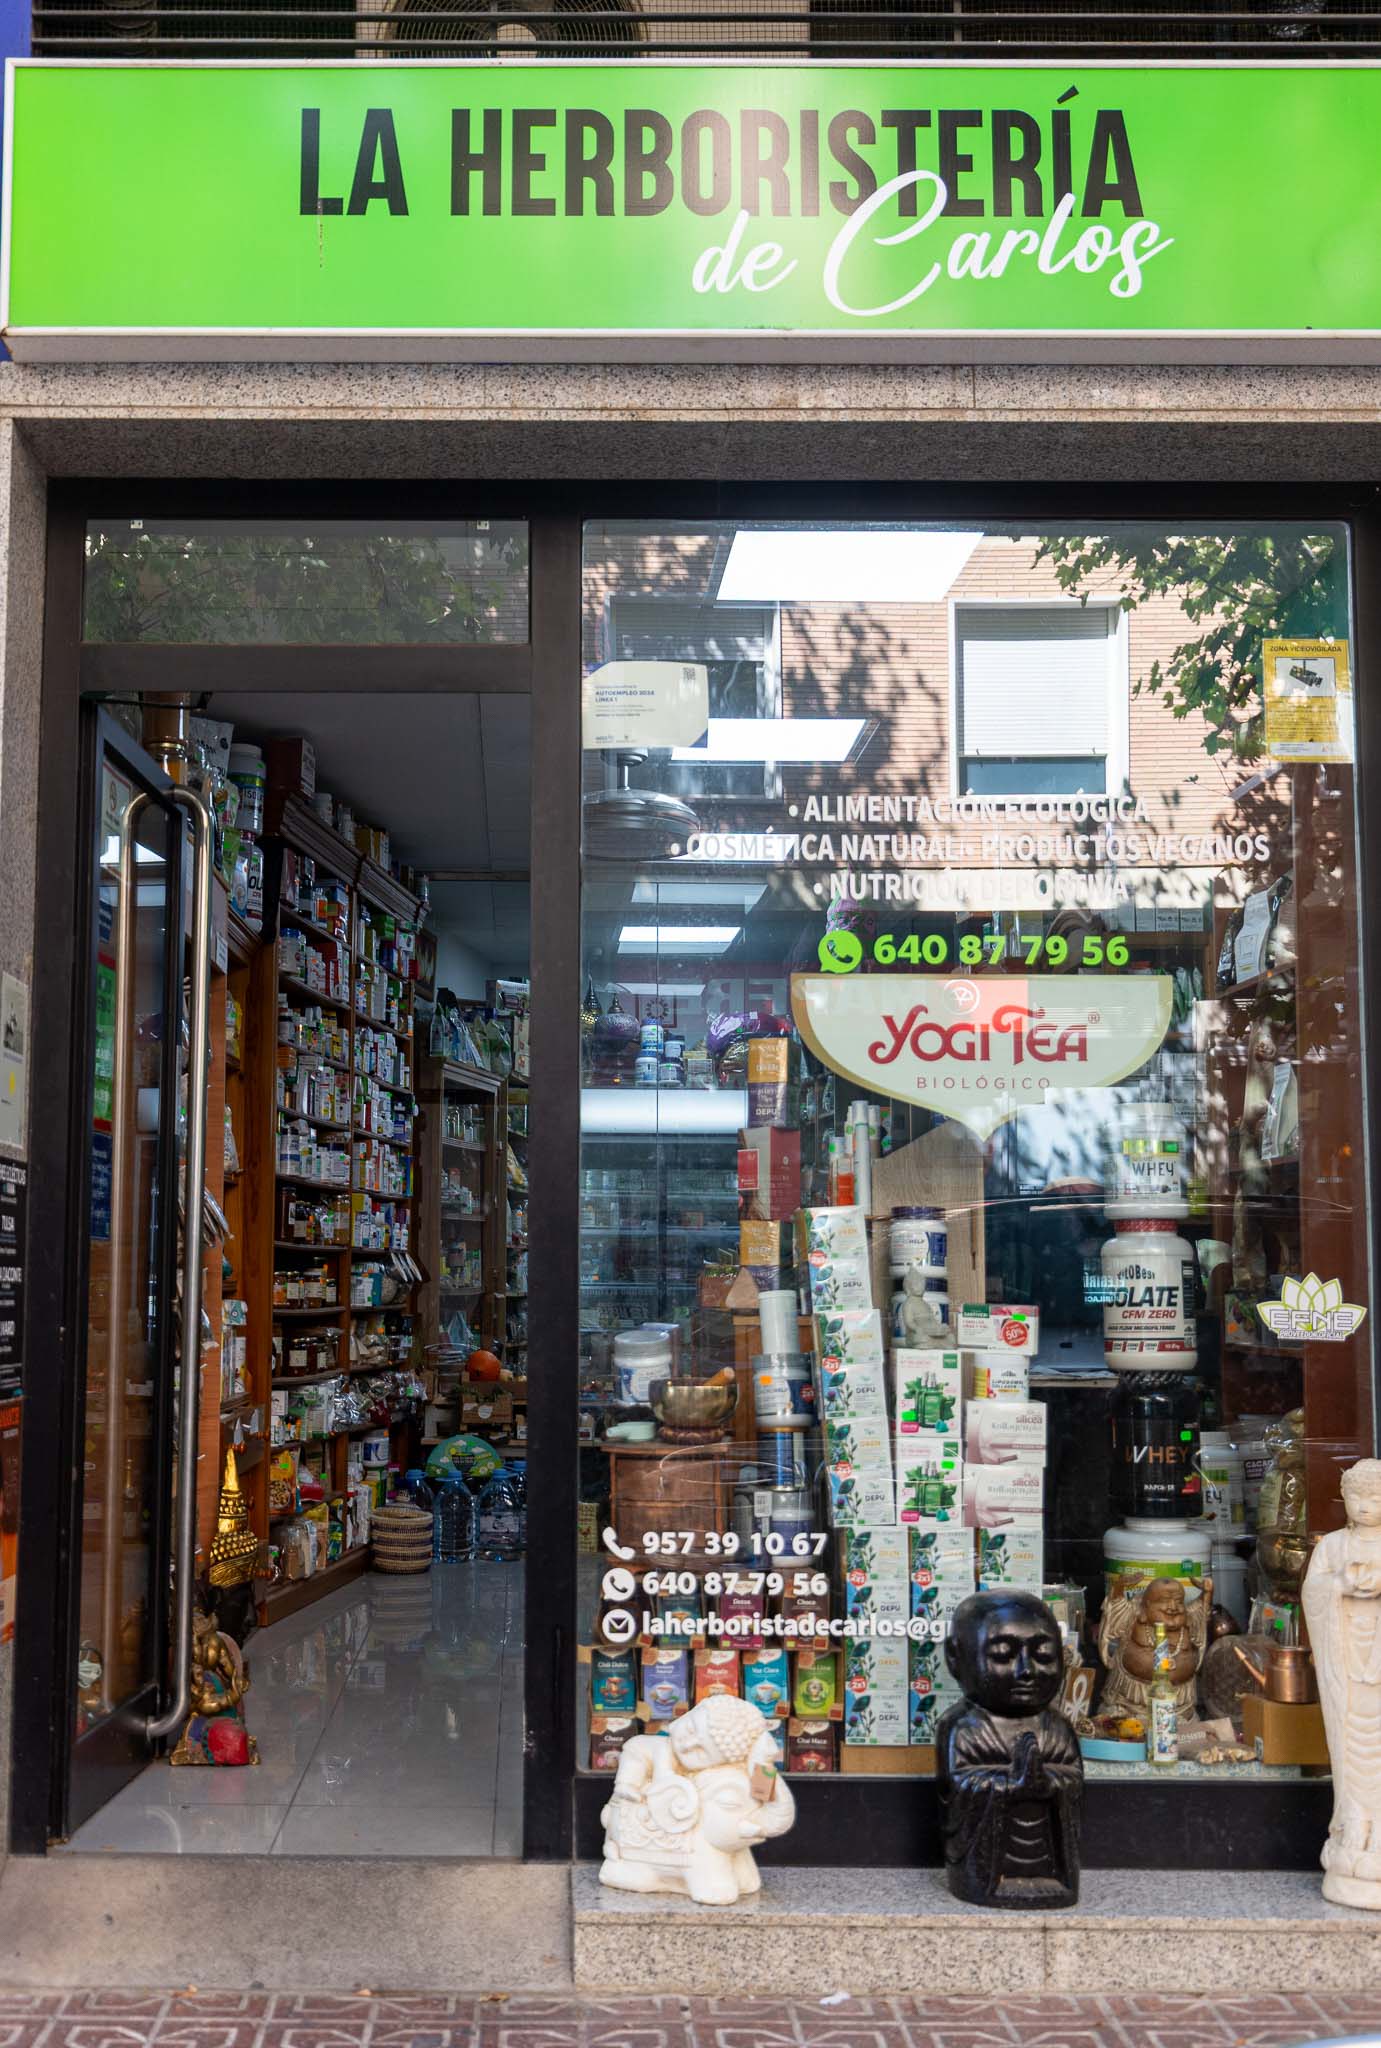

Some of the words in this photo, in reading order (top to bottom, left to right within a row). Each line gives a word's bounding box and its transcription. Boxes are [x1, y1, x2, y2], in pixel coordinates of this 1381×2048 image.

[299, 107, 410, 217] LA
[450, 84, 1144, 217] HERBORISTERÍA
[691, 208, 798, 293] de
[823, 169, 1175, 316] Carlos
[803, 787, 1001, 823] ALIMENTACIÓN
[1006, 787, 1149, 823] ECOLÓGICA
[686, 825, 835, 861] COSMÉTICA
[841, 834, 960, 861] NATURAL
[980, 834, 1143, 862] PRODUCTOS
[1146, 834, 1271, 862] VEGANOS
[873, 935, 948, 965] 640
[959, 936, 1006, 965] 87
[1021, 936, 1068, 965] 79
[1082, 936, 1130, 967] 56
[916, 1076, 1051, 1090] BIOLÓGICO
[1132, 1162, 1174, 1177] WHEY
[1122, 1309, 1146, 1319] CFM
[1148, 1309, 1177, 1319] ZERO
[1269, 1308, 1353, 1331] EFNE
[1124, 1445, 1188, 1464] WHEY
[642, 1531, 695, 1555] 957
[704, 1532, 740, 1555] 39
[751, 1532, 785, 1555] 10
[792, 1532, 828, 1556] 67
[642, 1571, 697, 1595] 640
[704, 1572, 739, 1596] 87
[749, 1572, 784, 1596] 79
[792, 1572, 828, 1596] 56
[880, 1604, 901, 1612] DEPU
